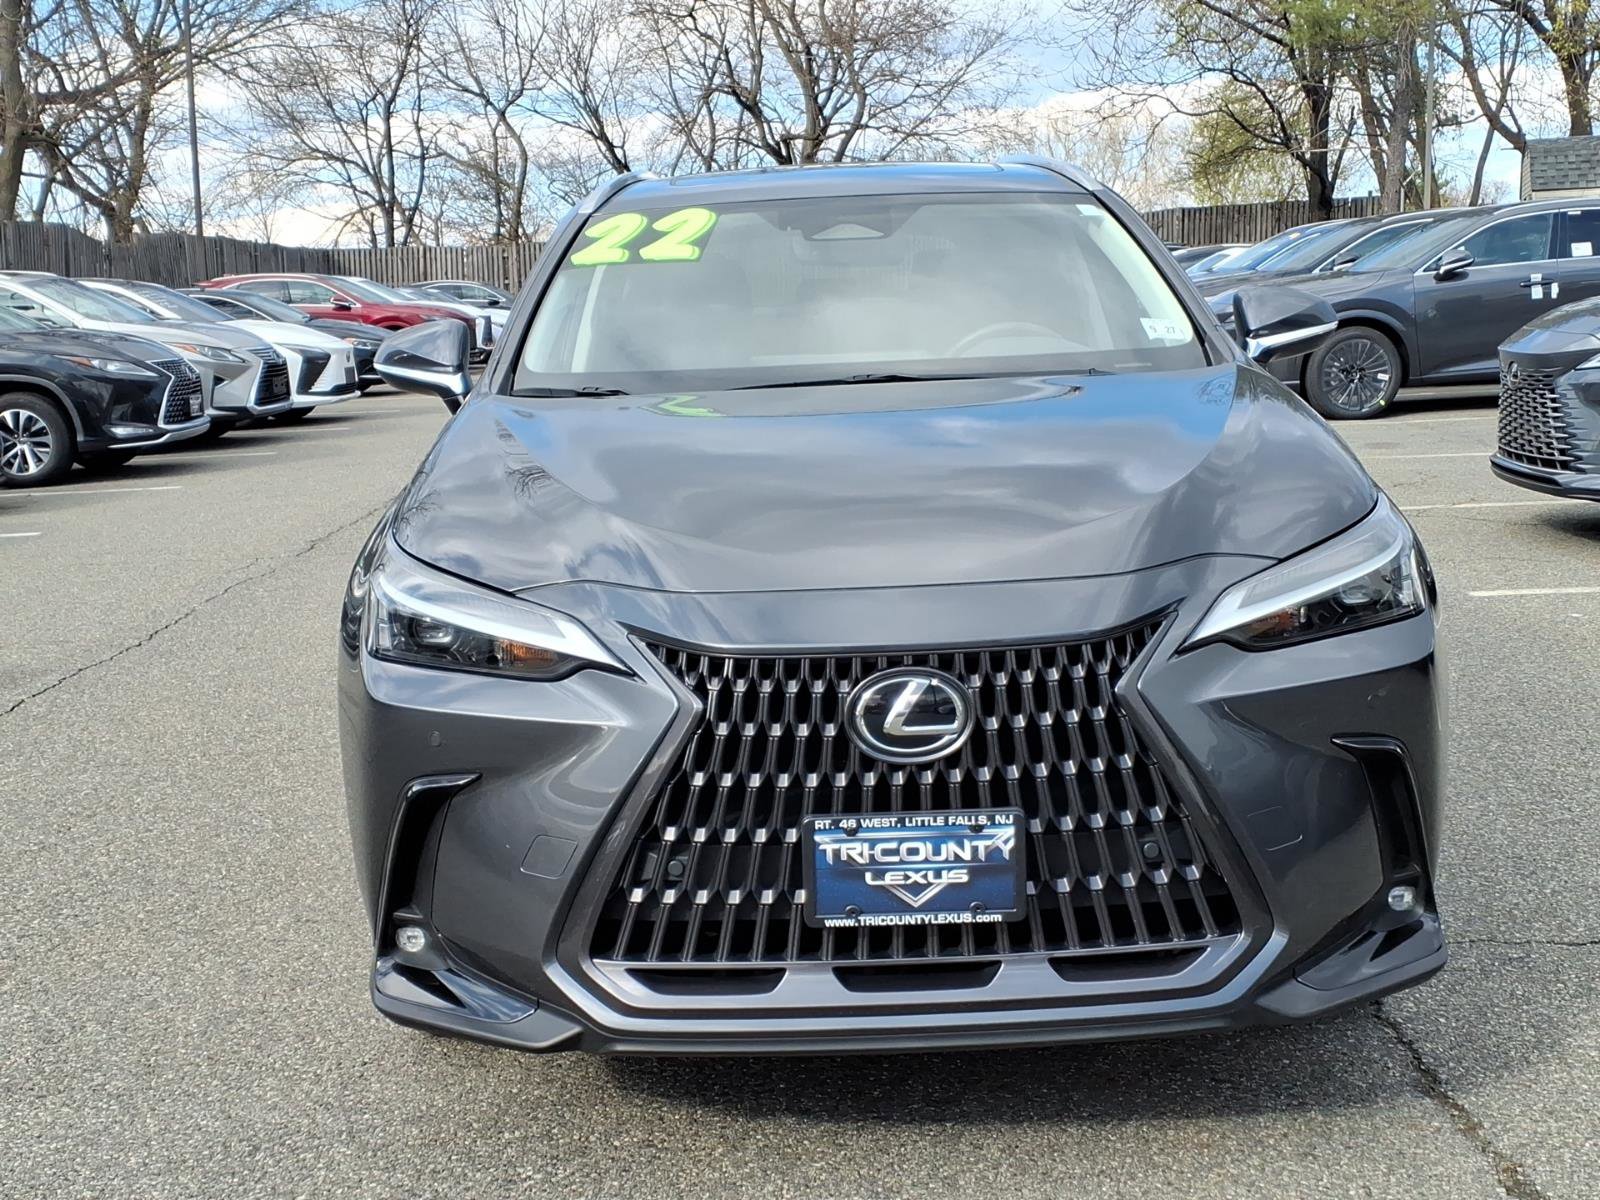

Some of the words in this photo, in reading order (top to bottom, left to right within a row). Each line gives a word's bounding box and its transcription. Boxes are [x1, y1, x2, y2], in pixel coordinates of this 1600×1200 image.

[570, 207, 717, 266] 22
[814, 819, 835, 830] RT.
[839, 819, 857, 829] 46
[860, 817, 901, 829] WEST,
[905, 816, 947, 827] LITTLE
[948, 815, 991, 826] FALLS,
[995, 814, 1014, 825] NJ
[864, 868, 970, 886] LEXUS
[824, 913, 1003, 928] www.TRICOUNTYLEXUS.com
